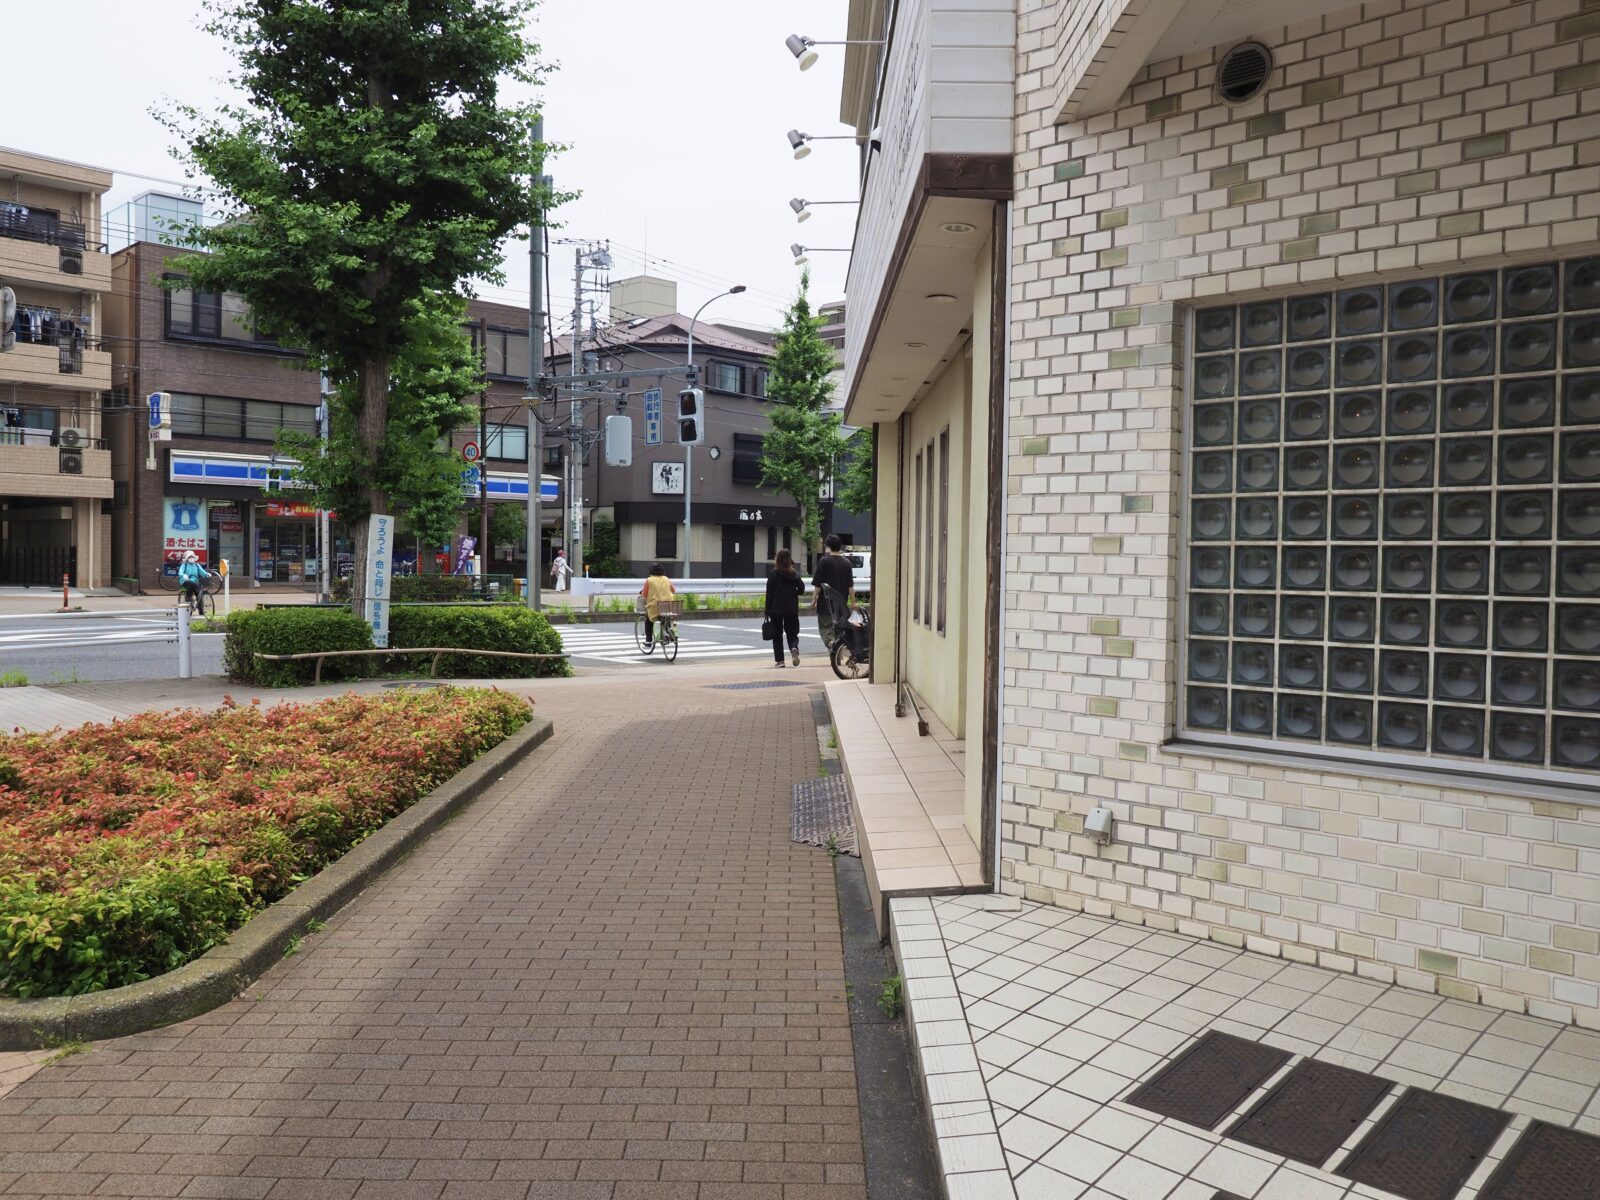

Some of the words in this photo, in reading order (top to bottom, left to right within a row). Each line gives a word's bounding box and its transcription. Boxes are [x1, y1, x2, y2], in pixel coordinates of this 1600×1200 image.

[651, 422, 657, 441] 専用
[466, 447, 476, 457] 40
[377, 518, 387, 555] 守ろうよ
[375, 559, 384, 596] 命と同じ
